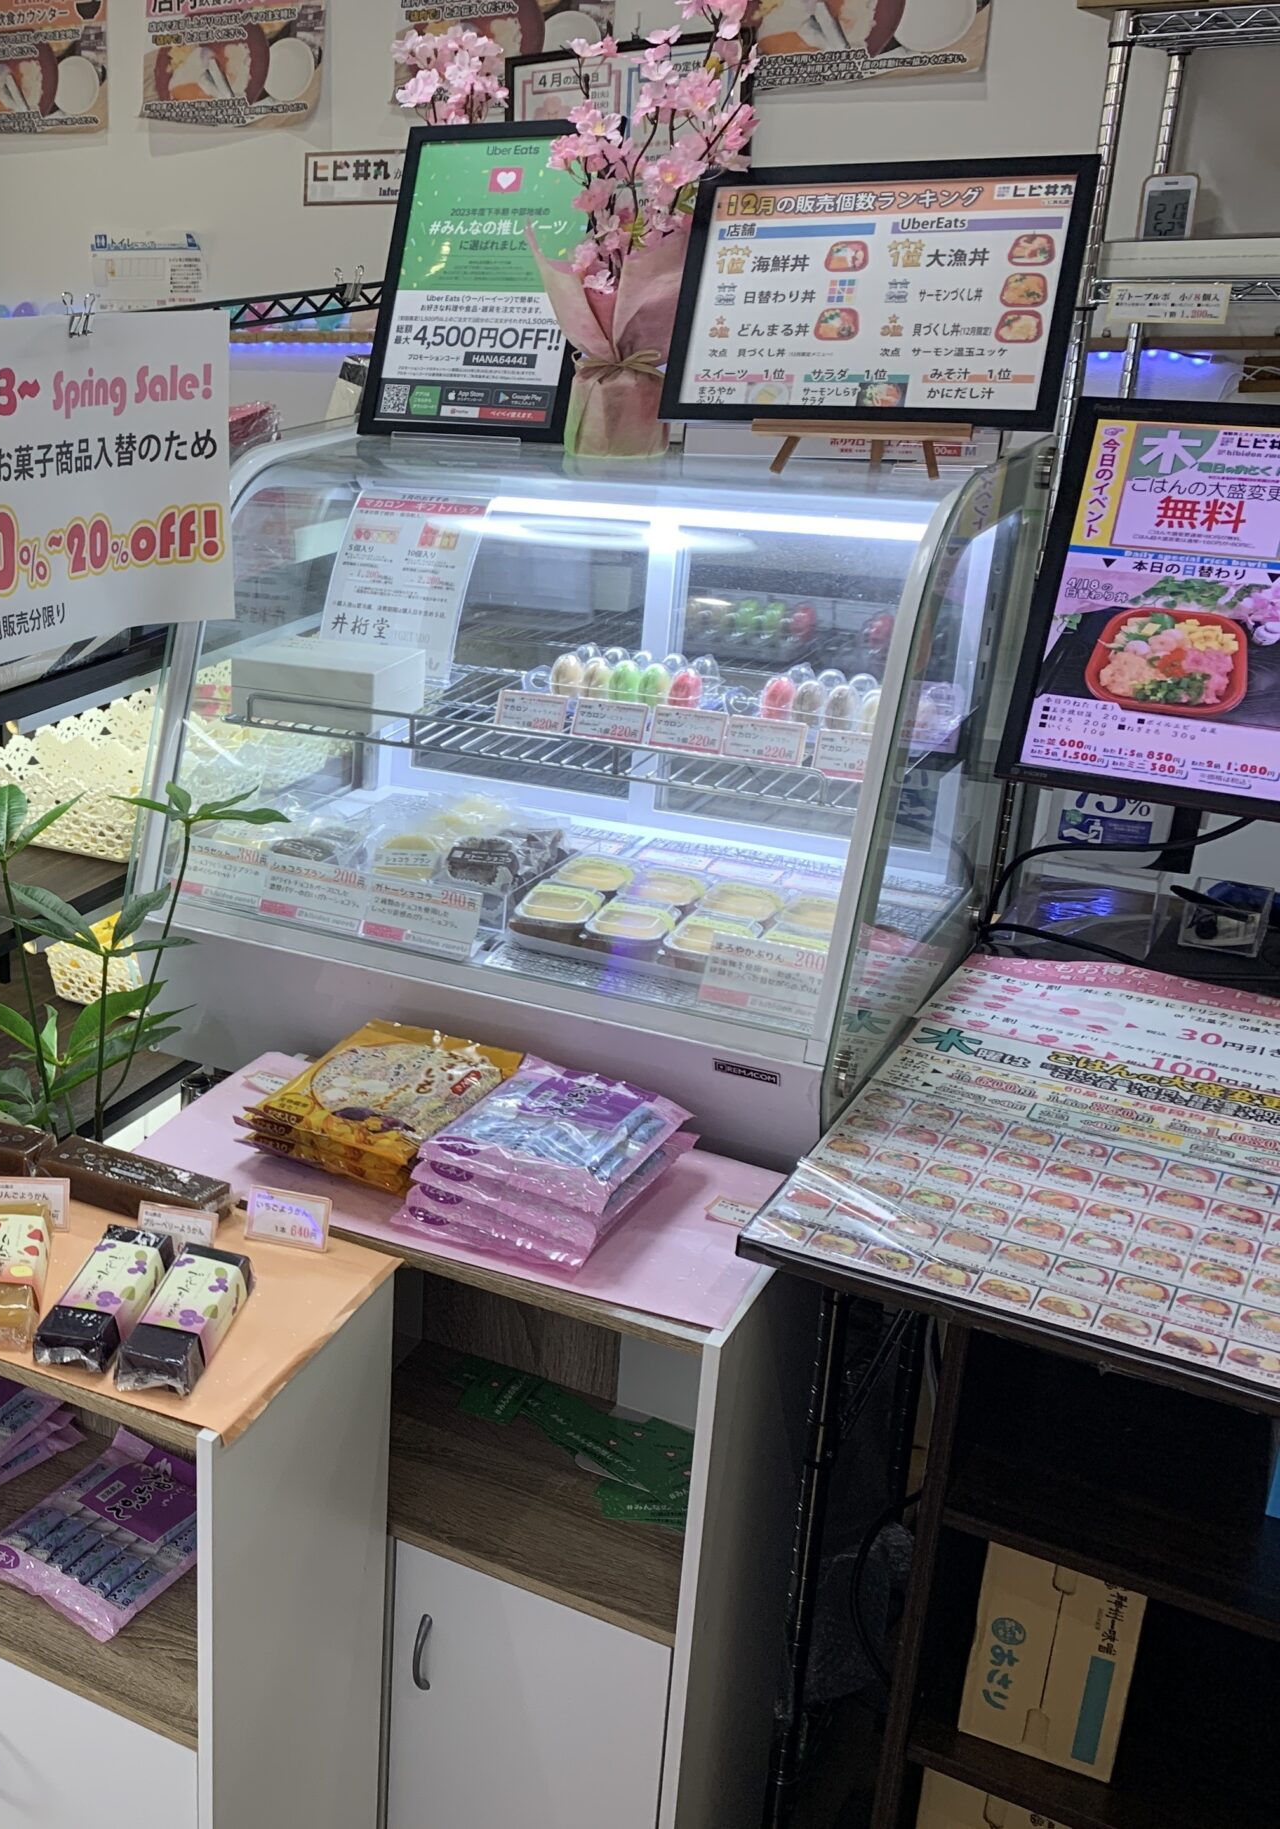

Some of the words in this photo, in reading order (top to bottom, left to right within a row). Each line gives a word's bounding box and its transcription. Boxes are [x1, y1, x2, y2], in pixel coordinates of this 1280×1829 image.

[486, 145, 512, 156] Uber
[513, 144, 540, 156] Eats
[312, 158, 392, 183] ヒビ丼丸
[1012, 183, 1074, 198] ヒビ丼丸
[726, 186, 984, 216] 12月の販売個数ランキング
[726, 223, 756, 237] 店舗
[900, 216, 967, 231] UberEats
[459, 239, 528, 252] に選ばれました
[716, 258, 745, 275] 1位
[751, 254, 810, 273] 海鮮丼
[888, 250, 922, 268] 1位
[925, 247, 990, 268] 大漁丼
[426, 294, 444, 302] Uber
[445, 294, 461, 302] Eats
[743, 289, 817, 304] 日替わり丼
[919, 287, 984, 302] サーモンづくし丼
[737, 322, 810, 337] どんまる丼
[393, 335, 411, 345] 最大
[412, 325, 562, 351] 4,500円OFF!!
[407, 353, 461, 362] プロモーションコード
[471, 354, 528, 366] HANA64441
[708, 348, 728, 358] 次点
[736, 348, 786, 358] 貝づくし丼
[880, 347, 901, 357] 次点
[911, 347, 1009, 358] サーモン温玉ユッケ
[701, 368, 749, 380] スイーツ
[762, 368, 786, 380] 1位
[811, 368, 850, 380] サラダ
[863, 368, 888, 381] 1位
[929, 368, 971, 381] みそ汁
[986, 368, 1013, 381] 1位
[52, 367, 128, 419] Spring
[133, 364, 213, 404] Sale!
[511, 392, 529, 400] Google
[529, 394, 543, 402] Play
[698, 386, 737, 396] まろやか
[802, 386, 858, 396] サーモンしらす
[926, 387, 995, 400] かにだし汁
[801, 396, 826, 405] サラダ
[1138, 429, 1202, 475] 木
[1086, 437, 1122, 539] 今日のイベント
[1131, 477, 1280, 502] ごはんの大盛変更
[1154, 495, 1247, 534] 無料
[1124, 550, 1155, 560] Daily
[1157, 551, 1203, 565] special
[1205, 556, 1229, 565] rice
[1231, 558, 1269, 569] bowls
[1132, 560, 1247, 580] 本日の日替わり
[1058, 737, 1092, 750] 600円
[1145, 750, 1181, 765] 850円
[273, 862, 326, 879] ショコラブラン
[333, 869, 366, 888] 200円
[374, 882, 433, 902] ガトーショコラ
[440, 889, 478, 911] 200円
[794, 950, 826, 971] 200
[726, 1063, 777, 1085] REMACOM
[254, 1199, 313, 1220] いちごようかん
[143, 1217, 205, 1236] ブルーベリーようかん
[290, 1225, 318, 1241] 640円
[981, 1644, 1021, 1711] あさり
